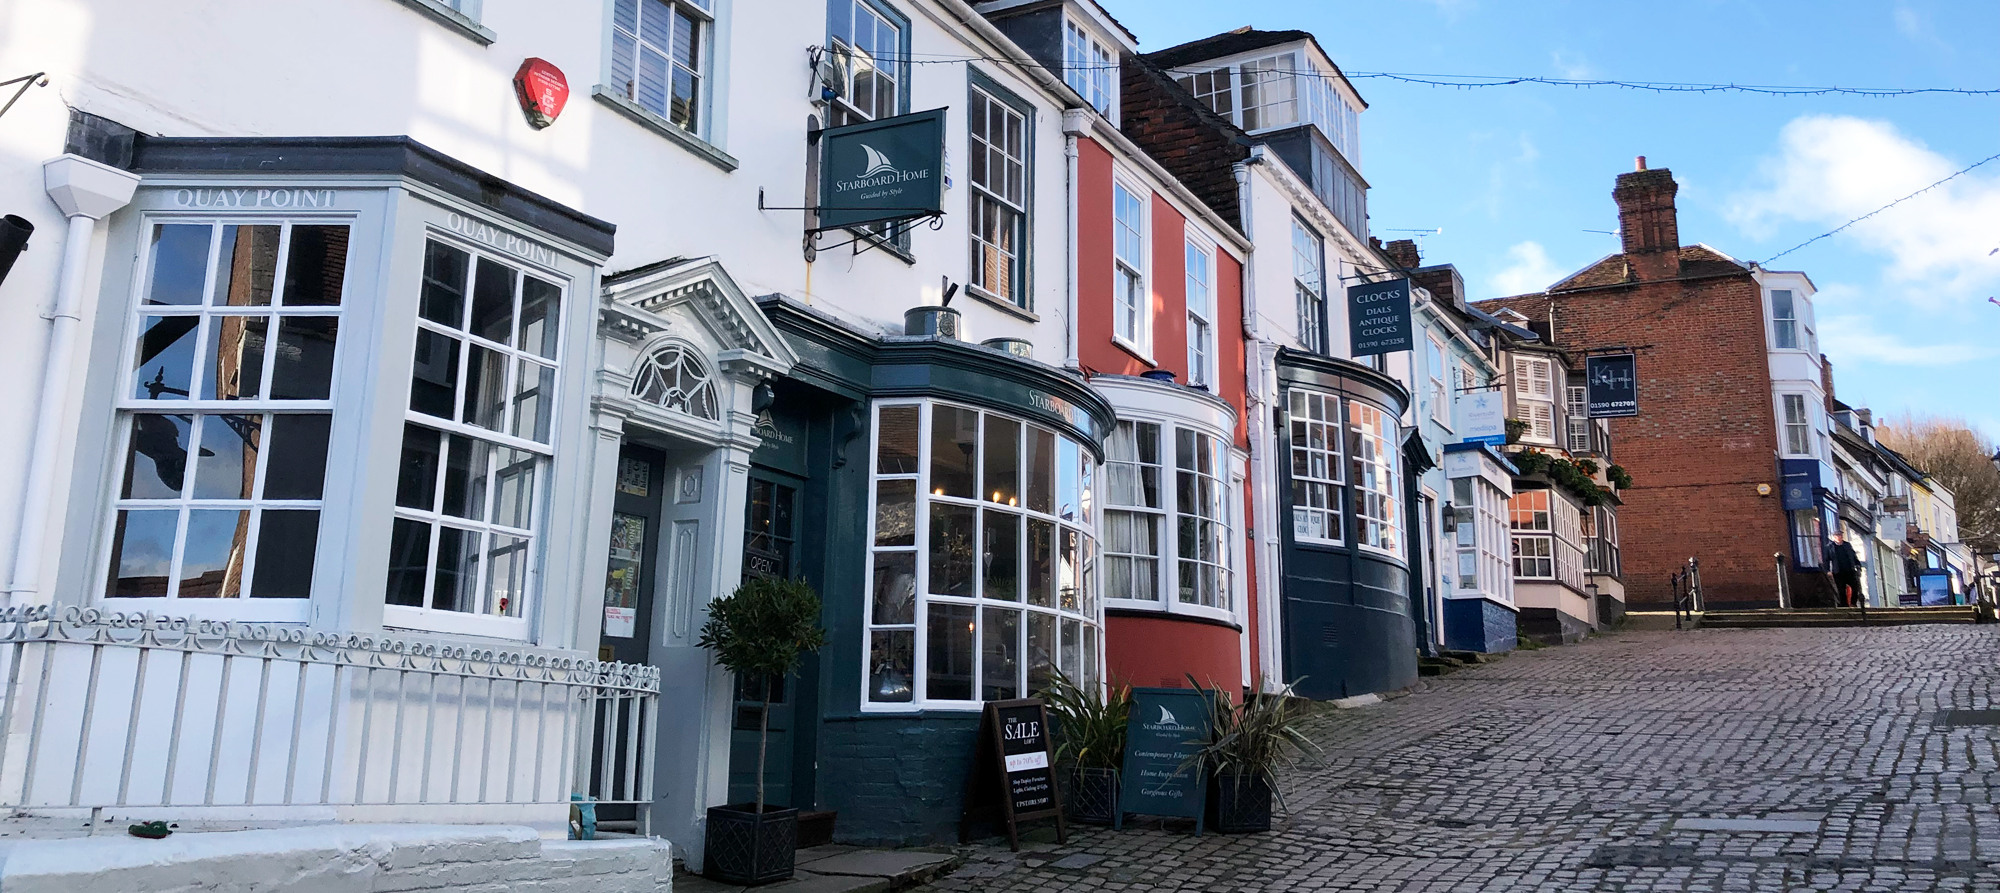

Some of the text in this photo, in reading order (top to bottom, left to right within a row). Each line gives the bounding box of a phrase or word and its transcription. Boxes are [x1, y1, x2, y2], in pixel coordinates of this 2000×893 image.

[836, 169, 929, 192] STARBOARD HOME
[174, 189, 337, 207] QUAY POINT
[861, 187, 903, 200] Guided by Style
[447, 212, 560, 267] QUAY POINT
[1356, 289, 1400, 304] CLOCKS
[1366, 305, 1392, 316] DIALS
[1359, 315, 1399, 327] ANTIQUE
[1362, 325, 1397, 337] CLOCKS
[1358, 340, 1378, 349] 01590
[1029, 389, 1074, 420] STARBOARD
[1590, 400, 1635, 409] 01590 672709
[750, 556, 773, 573] OPEN
[1005, 721, 1040, 740] SALE
[1134, 750, 1173, 760] Contemporary
[1168, 789, 1183, 799] Gifts
